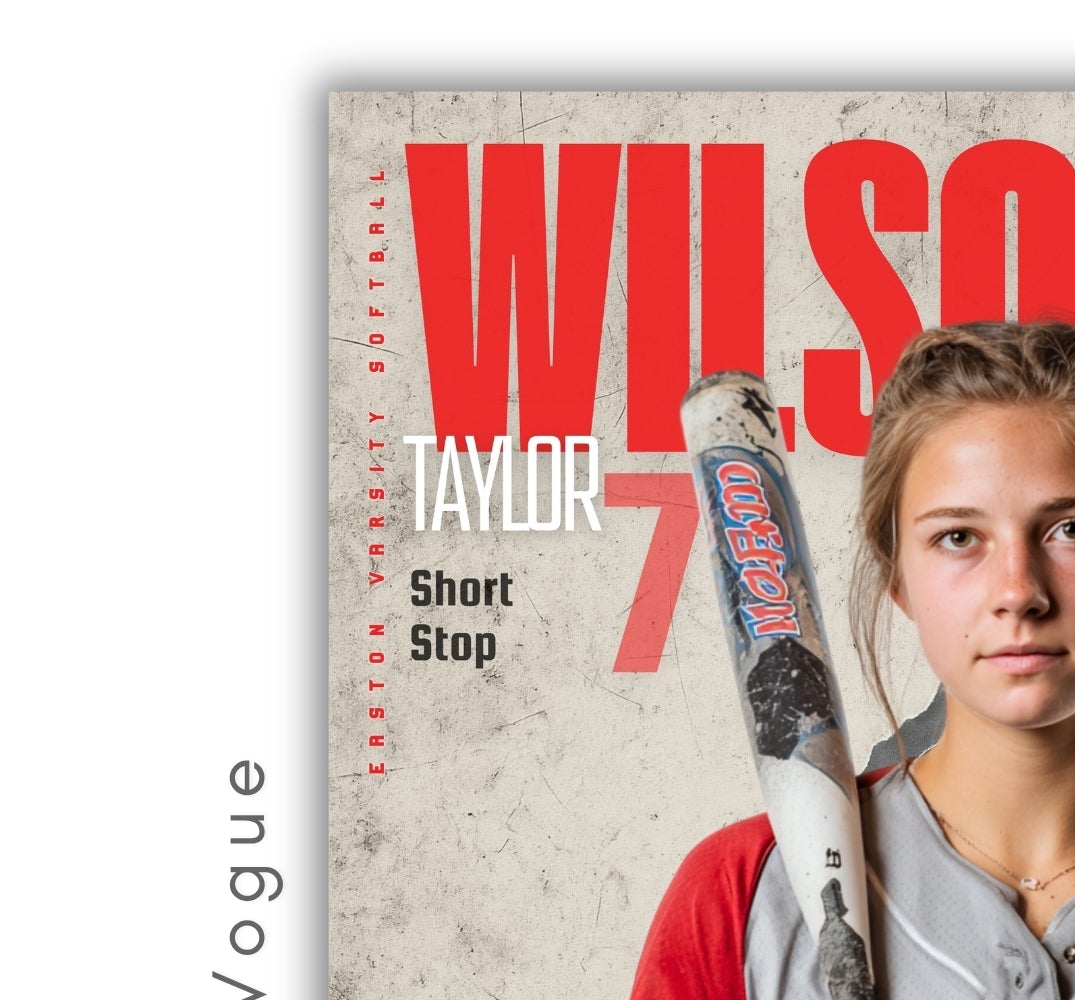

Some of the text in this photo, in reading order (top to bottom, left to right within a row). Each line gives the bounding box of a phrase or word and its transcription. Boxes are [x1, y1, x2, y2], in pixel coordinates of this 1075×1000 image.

[369, 171, 385, 774] EASTON VARSITY SOFTBALL
[403, 435, 602, 532] TAYLOR
[411, 569, 514, 608] Short
[604, 473, 701, 673] 7
[411, 624, 497, 669] Stop
